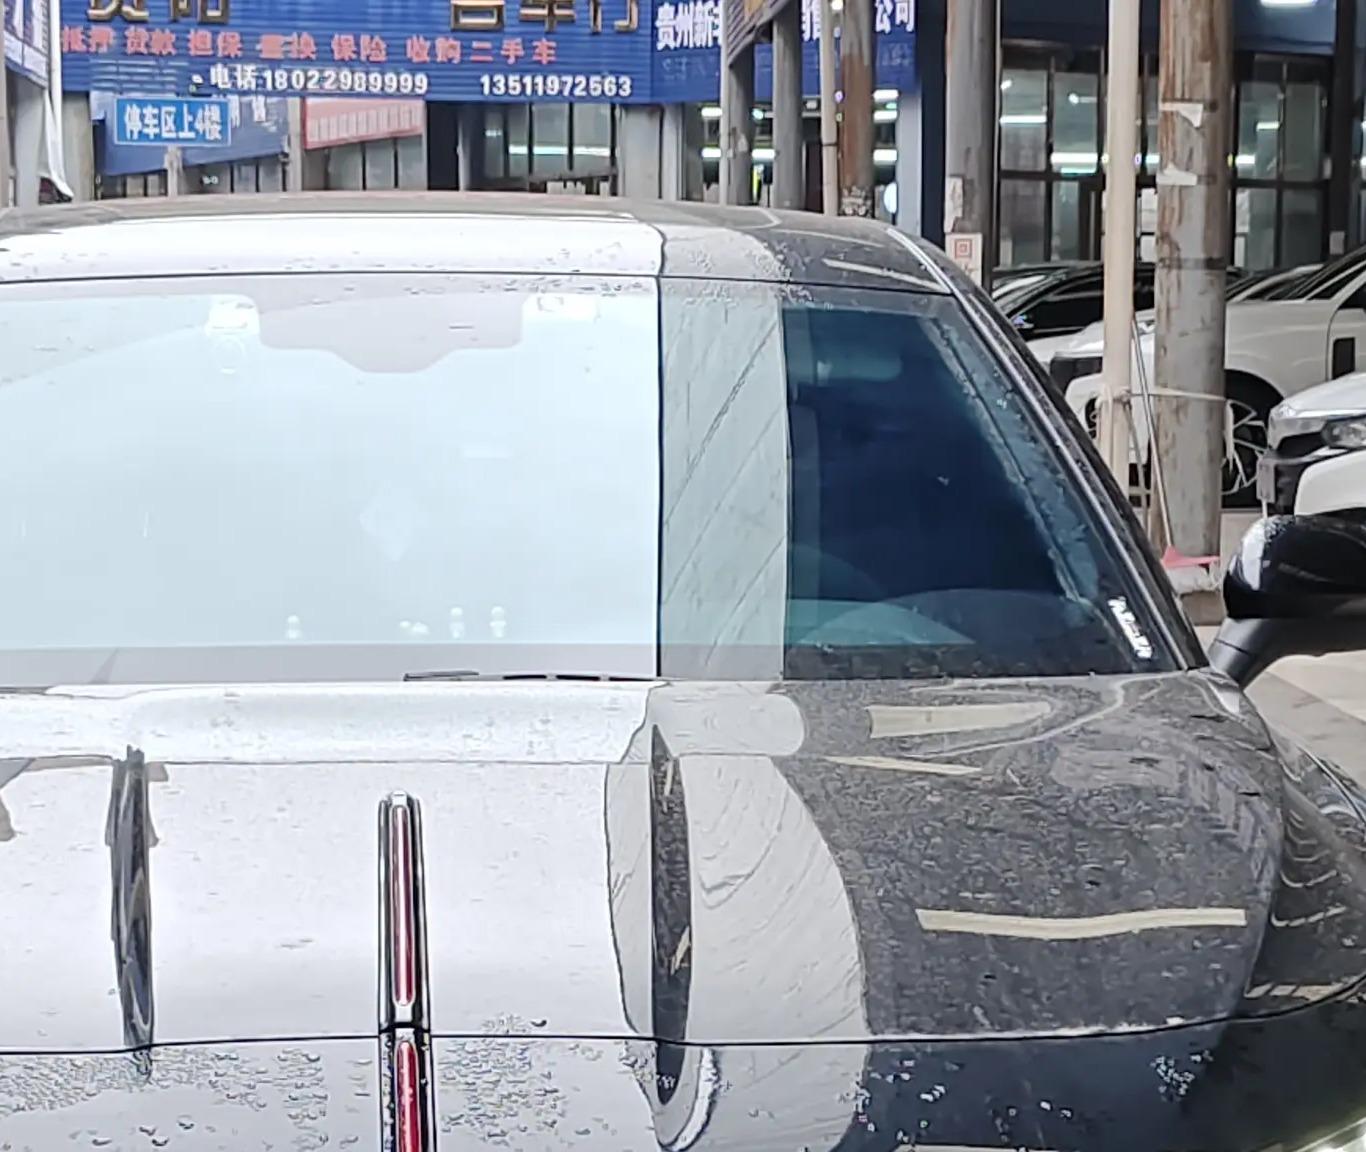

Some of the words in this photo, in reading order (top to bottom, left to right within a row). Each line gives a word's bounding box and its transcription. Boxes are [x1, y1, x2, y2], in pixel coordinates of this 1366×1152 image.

[62, 26, 115, 53] 抵押
[125, 25, 176, 56] 贷款
[187, 28, 243, 58] 担保
[331, 34, 387, 62] 保险
[480, 74, 632, 97] 13511972563
[124, 103, 223, 141] 停车区上4楼
